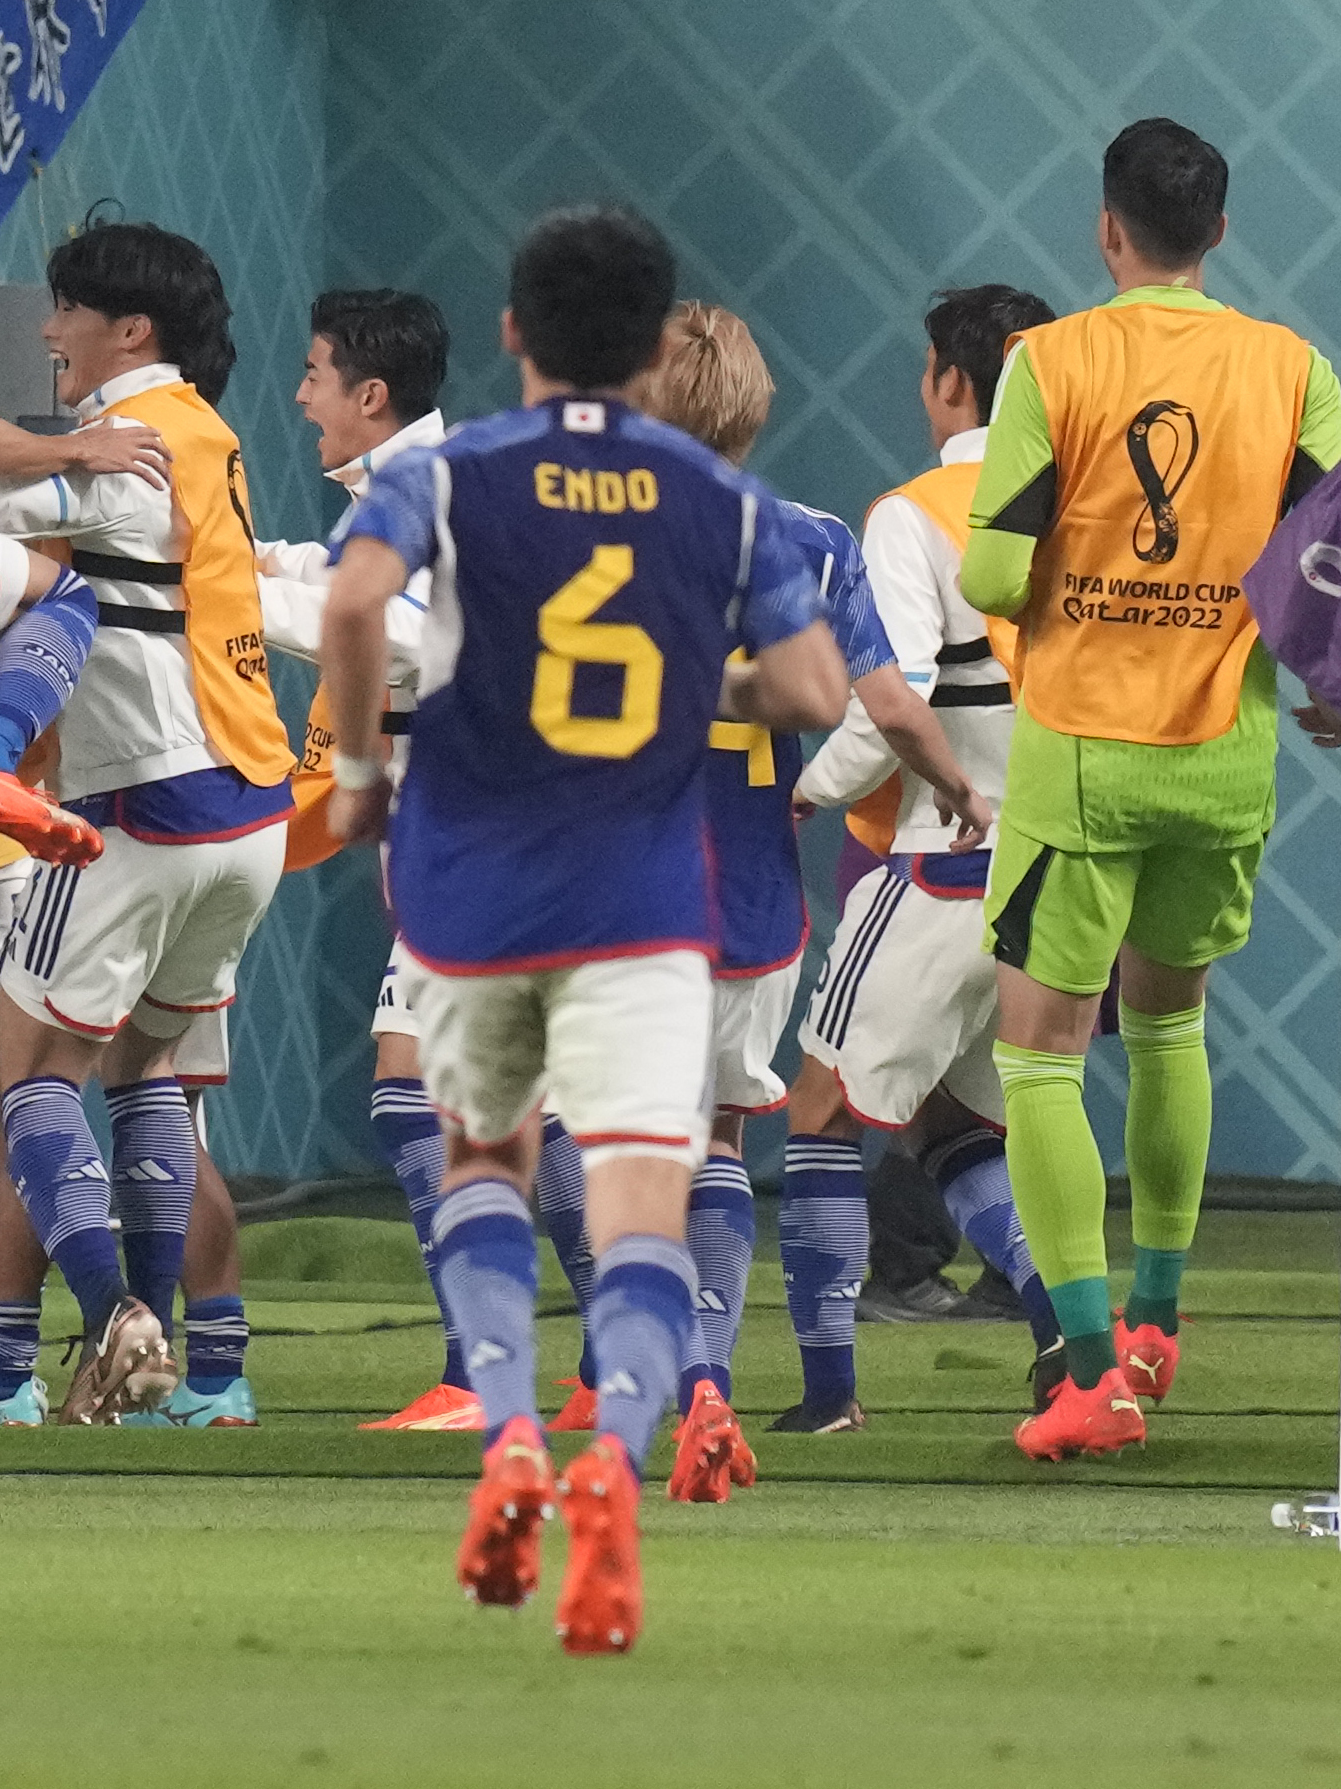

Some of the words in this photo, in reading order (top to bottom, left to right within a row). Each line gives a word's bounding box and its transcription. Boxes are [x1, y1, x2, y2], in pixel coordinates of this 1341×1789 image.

[534, 462, 658, 514] ENDO
[1065, 572, 1104, 595] FIFA
[1109, 578, 1190, 601] WORLD
[1194, 583, 1241, 604] CUP
[225, 632, 258, 657] FIFA
[530, 544, 664, 760] 6
[235, 654, 266, 682] Qat
